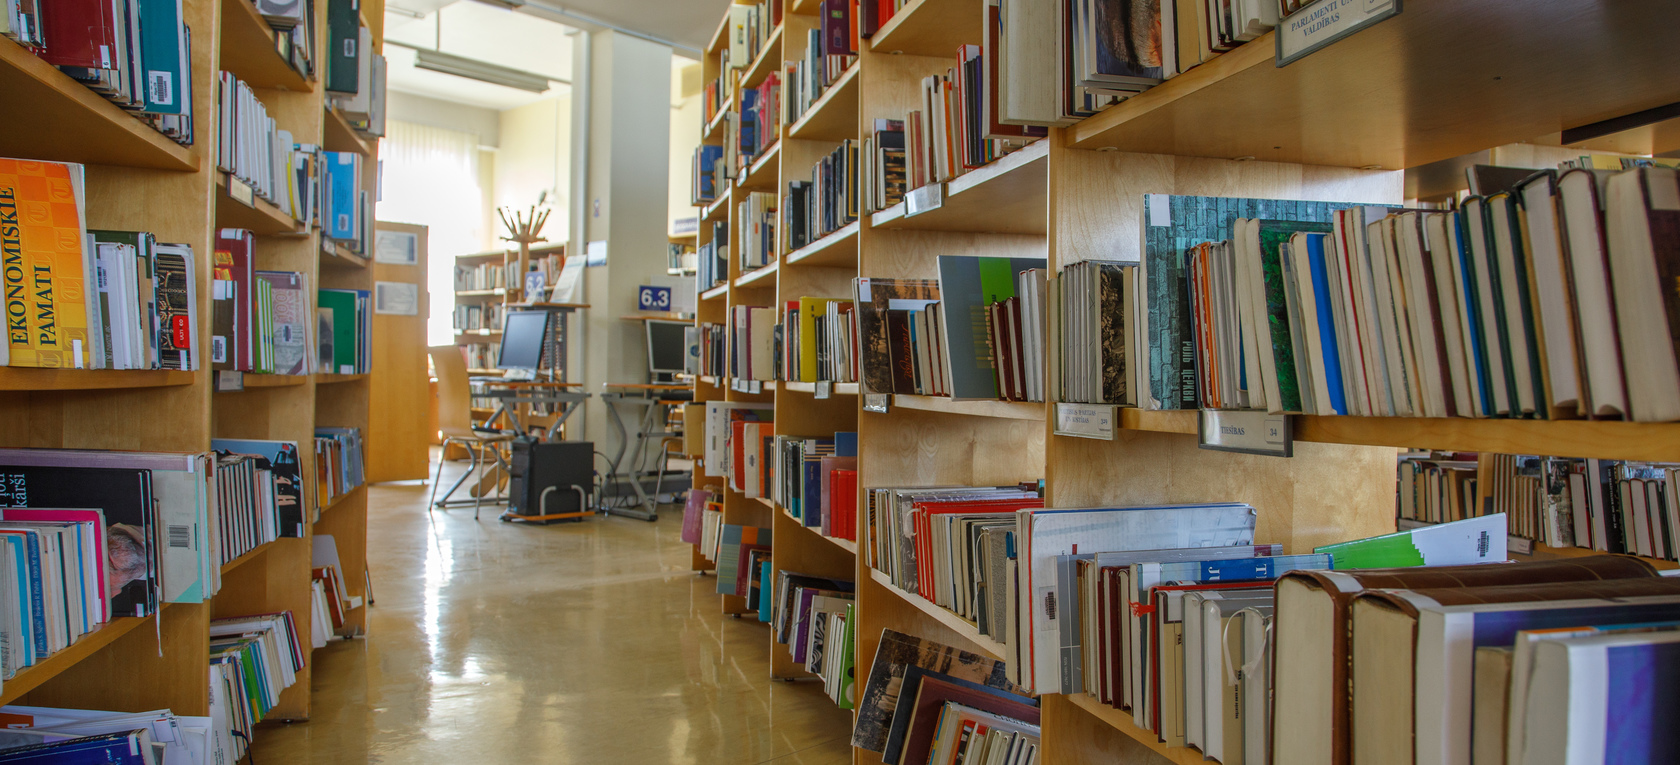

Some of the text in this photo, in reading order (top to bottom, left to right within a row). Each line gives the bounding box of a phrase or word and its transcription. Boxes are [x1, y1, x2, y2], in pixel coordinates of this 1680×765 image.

[1291, 1, 1338, 32] PARLAMENTI
[1303, 12, 1341, 37] VALDĪBAS
[1, 187, 29, 346] EKONOMISKIE
[33, 265, 57, 347] PAMATI
[641, 288, 669, 307] 6.3
[1181, 368, 1195, 402] ЦЕРКВИ
[1220, 425, 1246, 437] TIESĪBAS
[1269, 427, 1278, 438] 34
